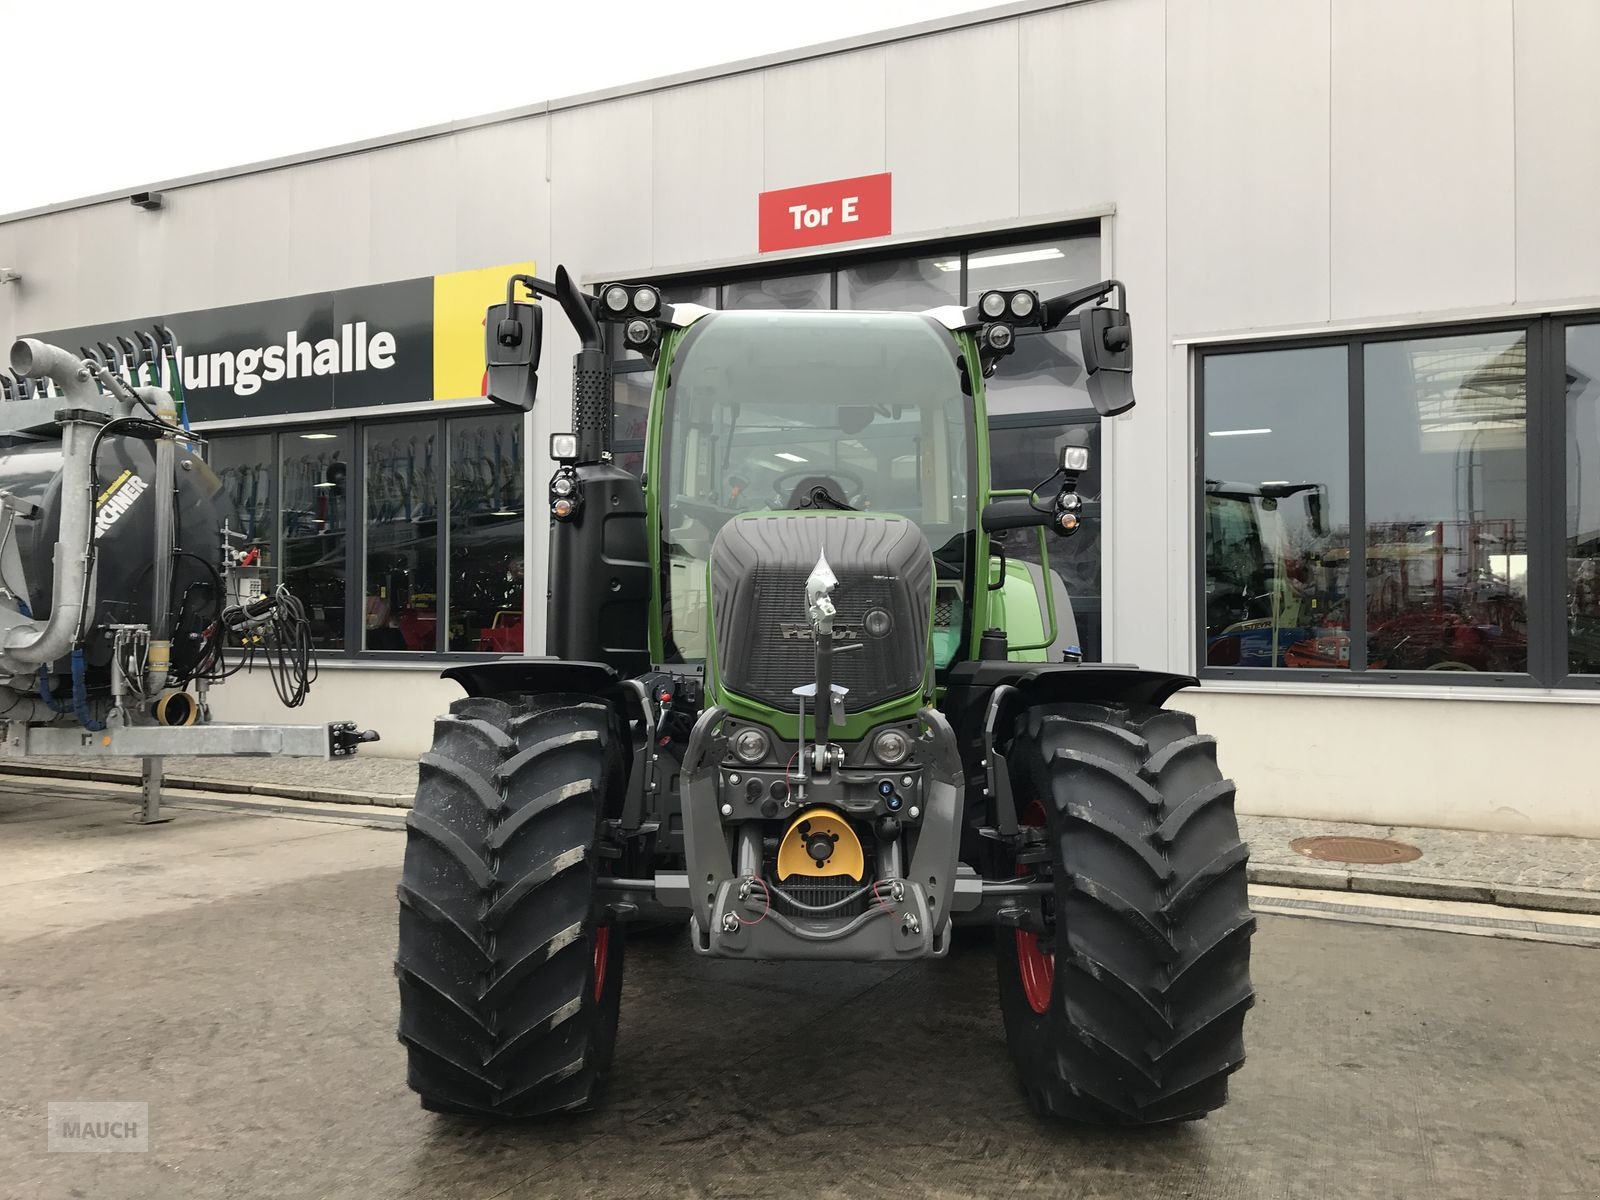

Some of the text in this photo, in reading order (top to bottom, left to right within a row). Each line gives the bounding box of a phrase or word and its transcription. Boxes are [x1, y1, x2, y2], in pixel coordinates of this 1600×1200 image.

[788, 196, 859, 230] Tor E
[95, 475, 149, 538] RCHNER
[780, 624, 863, 639] FEDT
